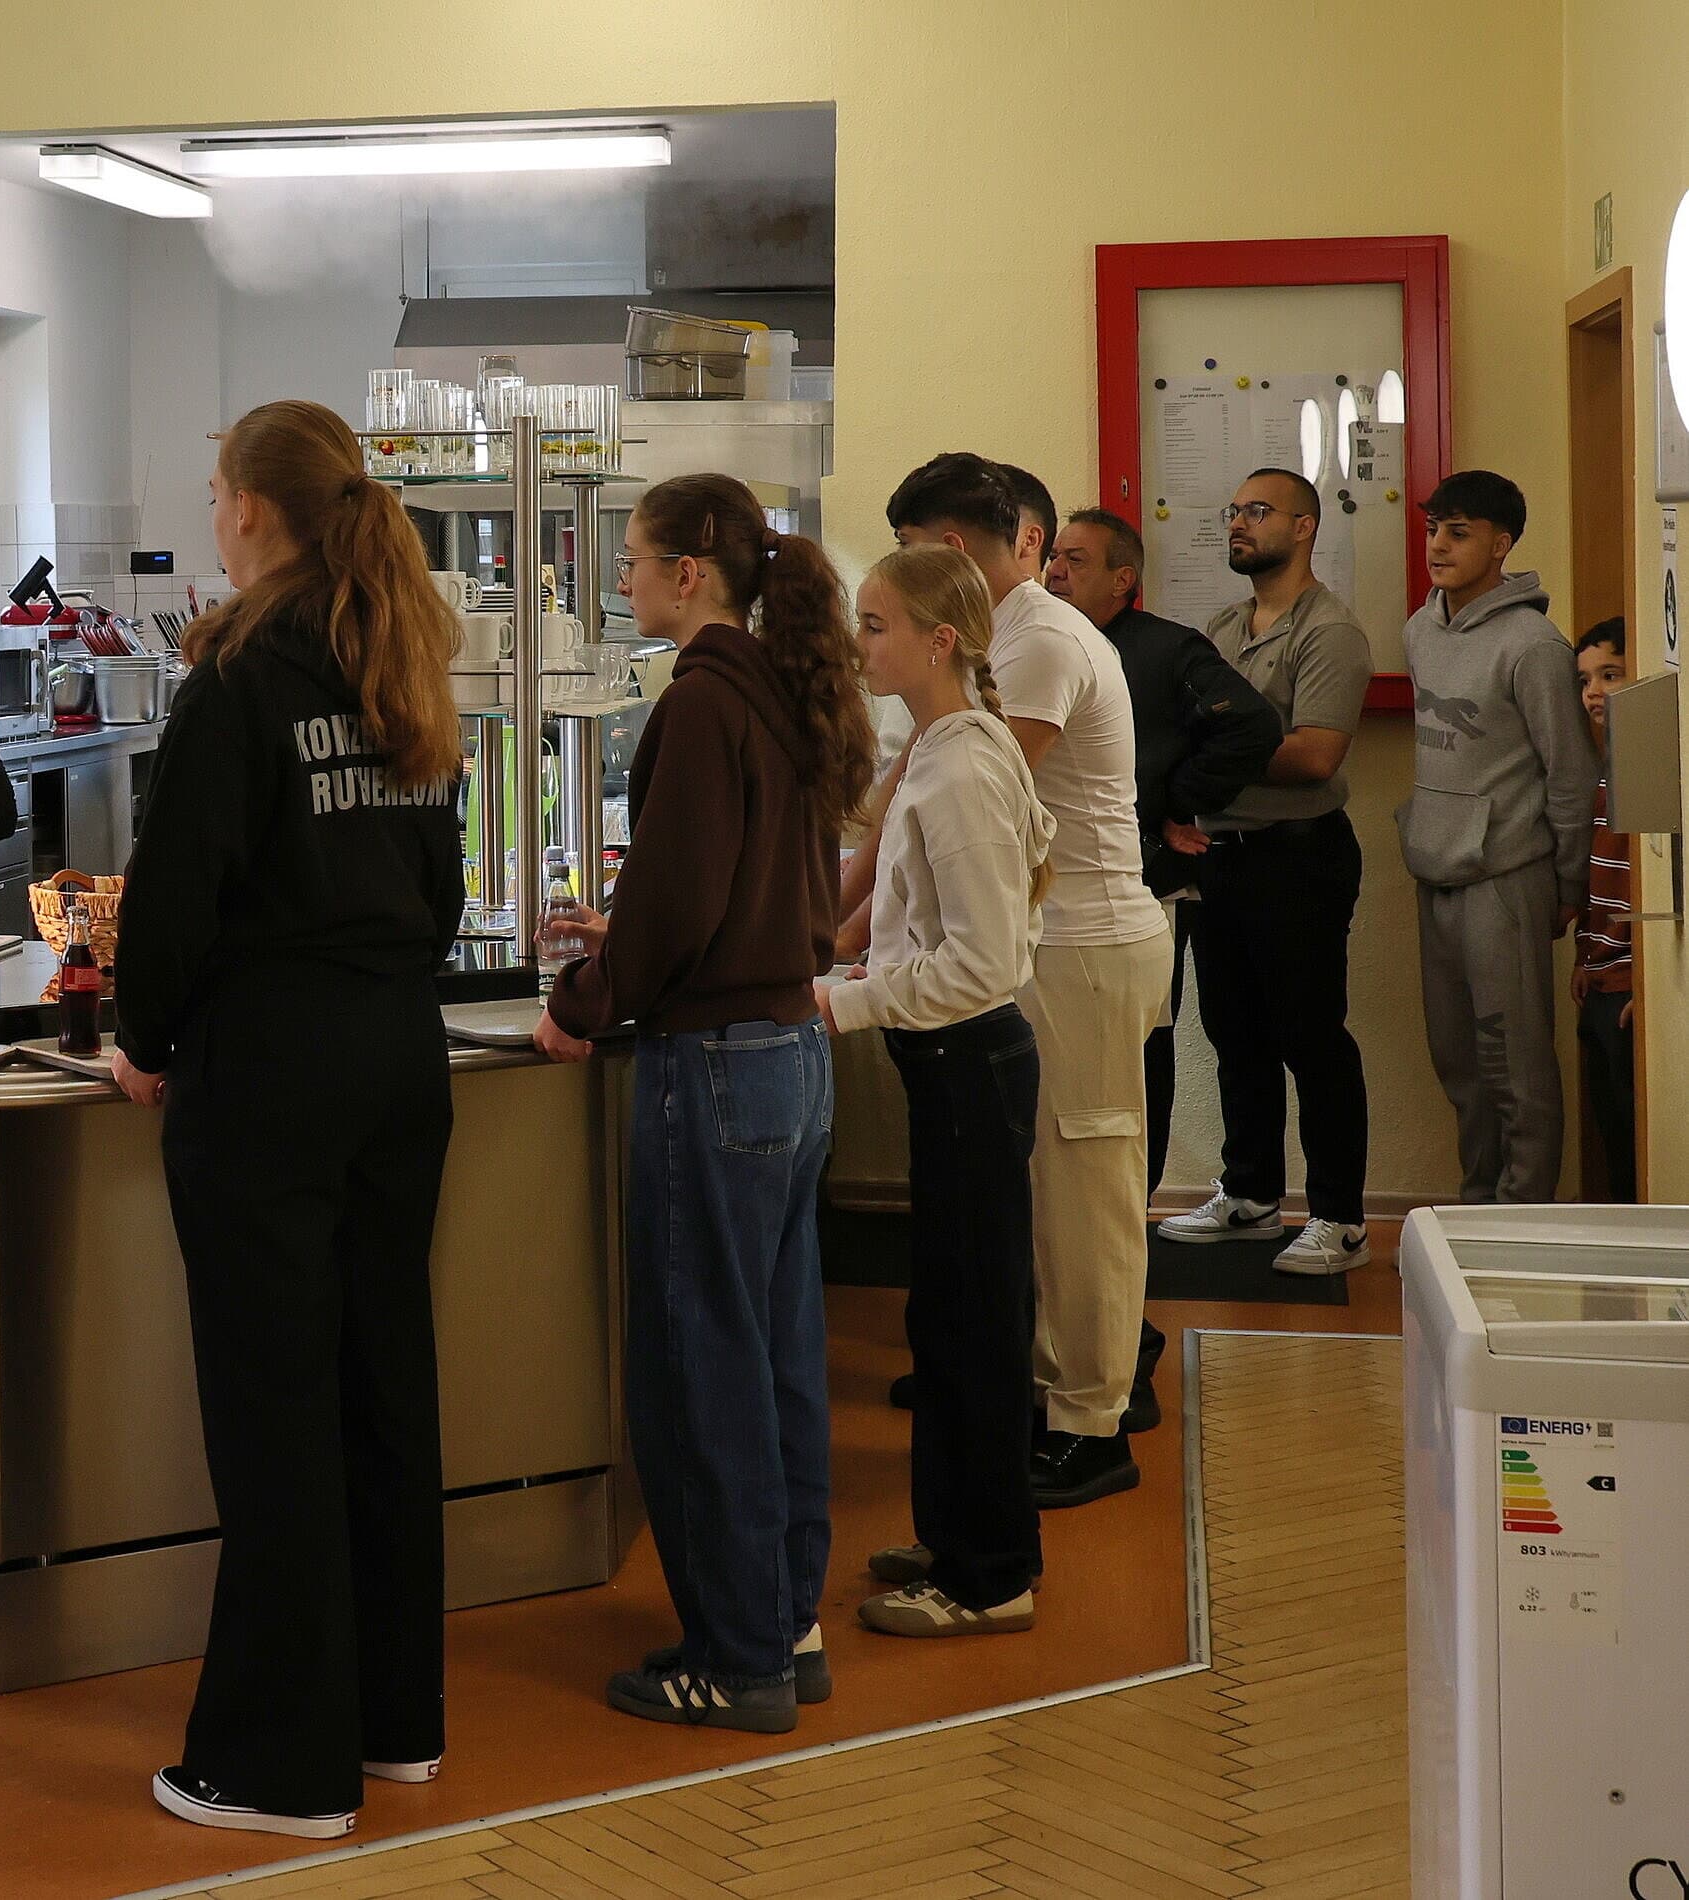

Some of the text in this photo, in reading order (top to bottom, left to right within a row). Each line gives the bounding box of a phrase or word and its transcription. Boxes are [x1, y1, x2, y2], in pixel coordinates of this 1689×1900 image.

[1529, 1420, 1585, 1435] ENERG
[1601, 1478, 1610, 1489] C
[1520, 1544, 1547, 1556] 803
